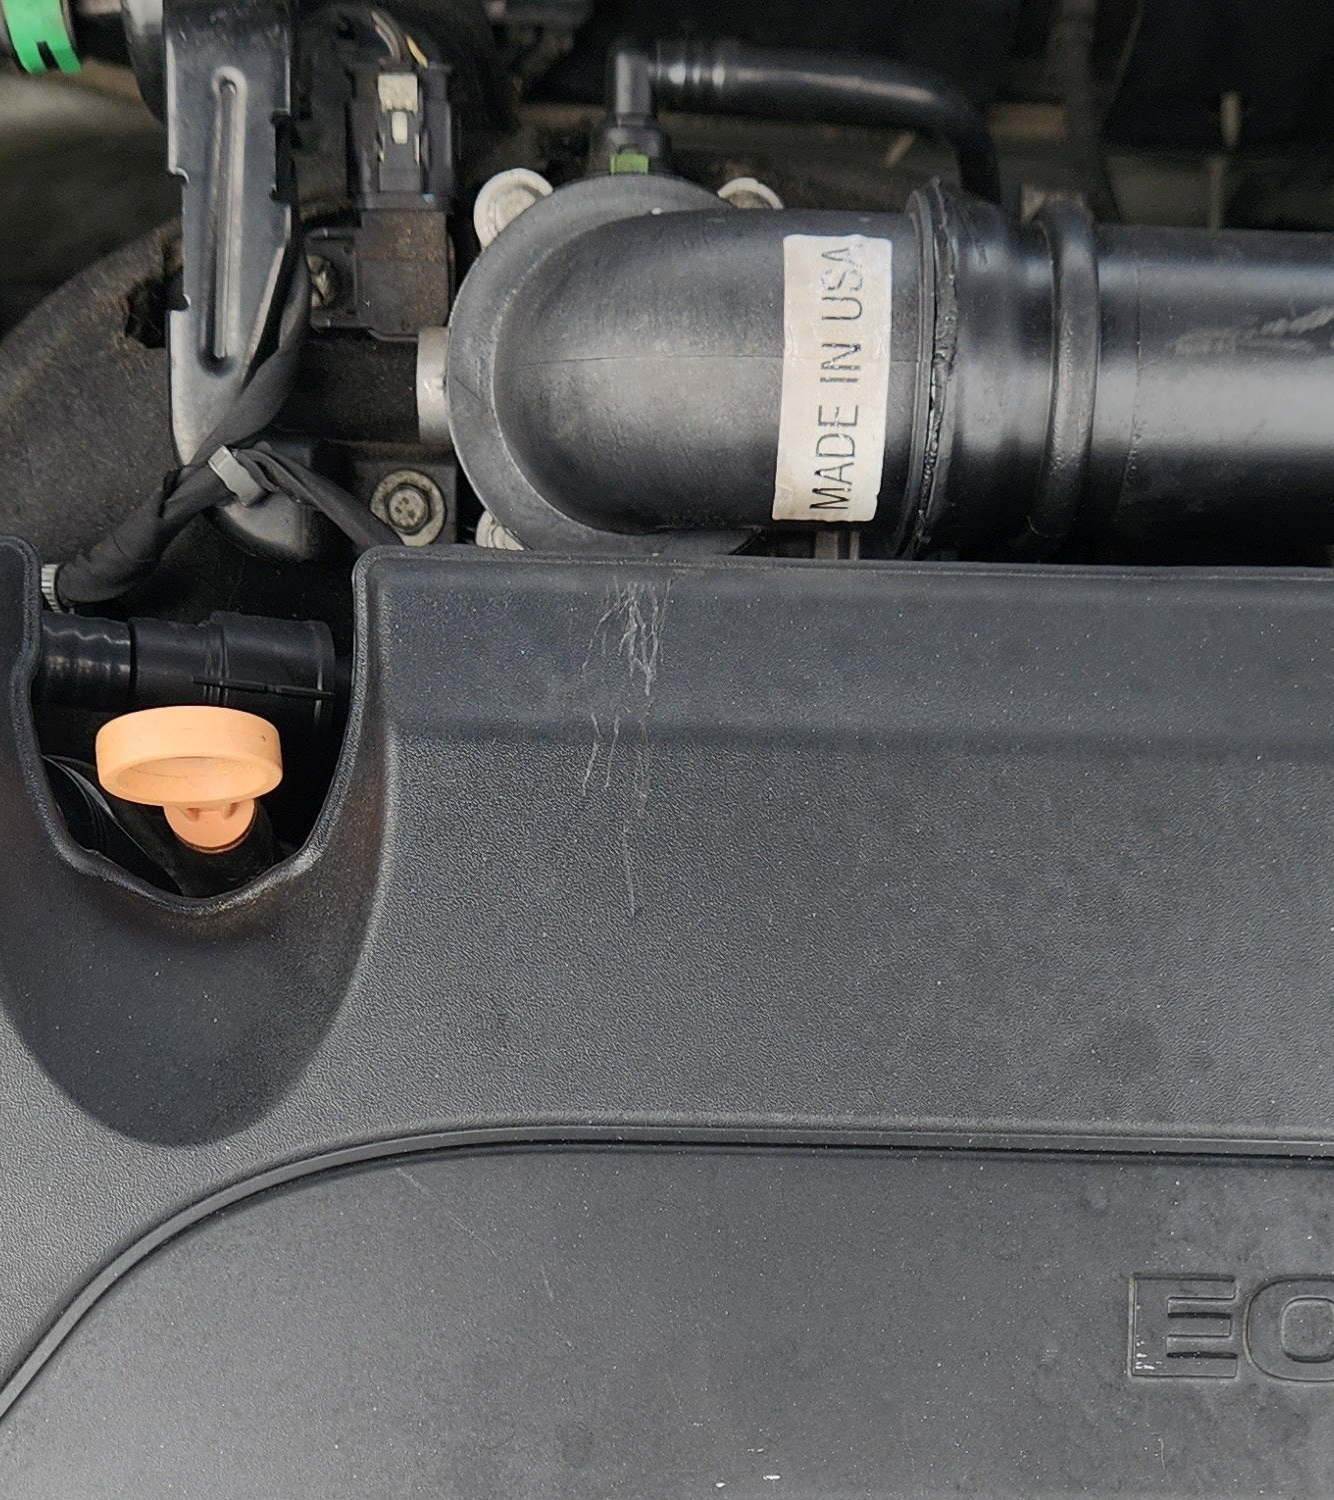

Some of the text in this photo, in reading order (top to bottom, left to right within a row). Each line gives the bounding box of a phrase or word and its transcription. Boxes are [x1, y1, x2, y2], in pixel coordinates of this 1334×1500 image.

[809, 243, 863, 509] MADE IN USA
